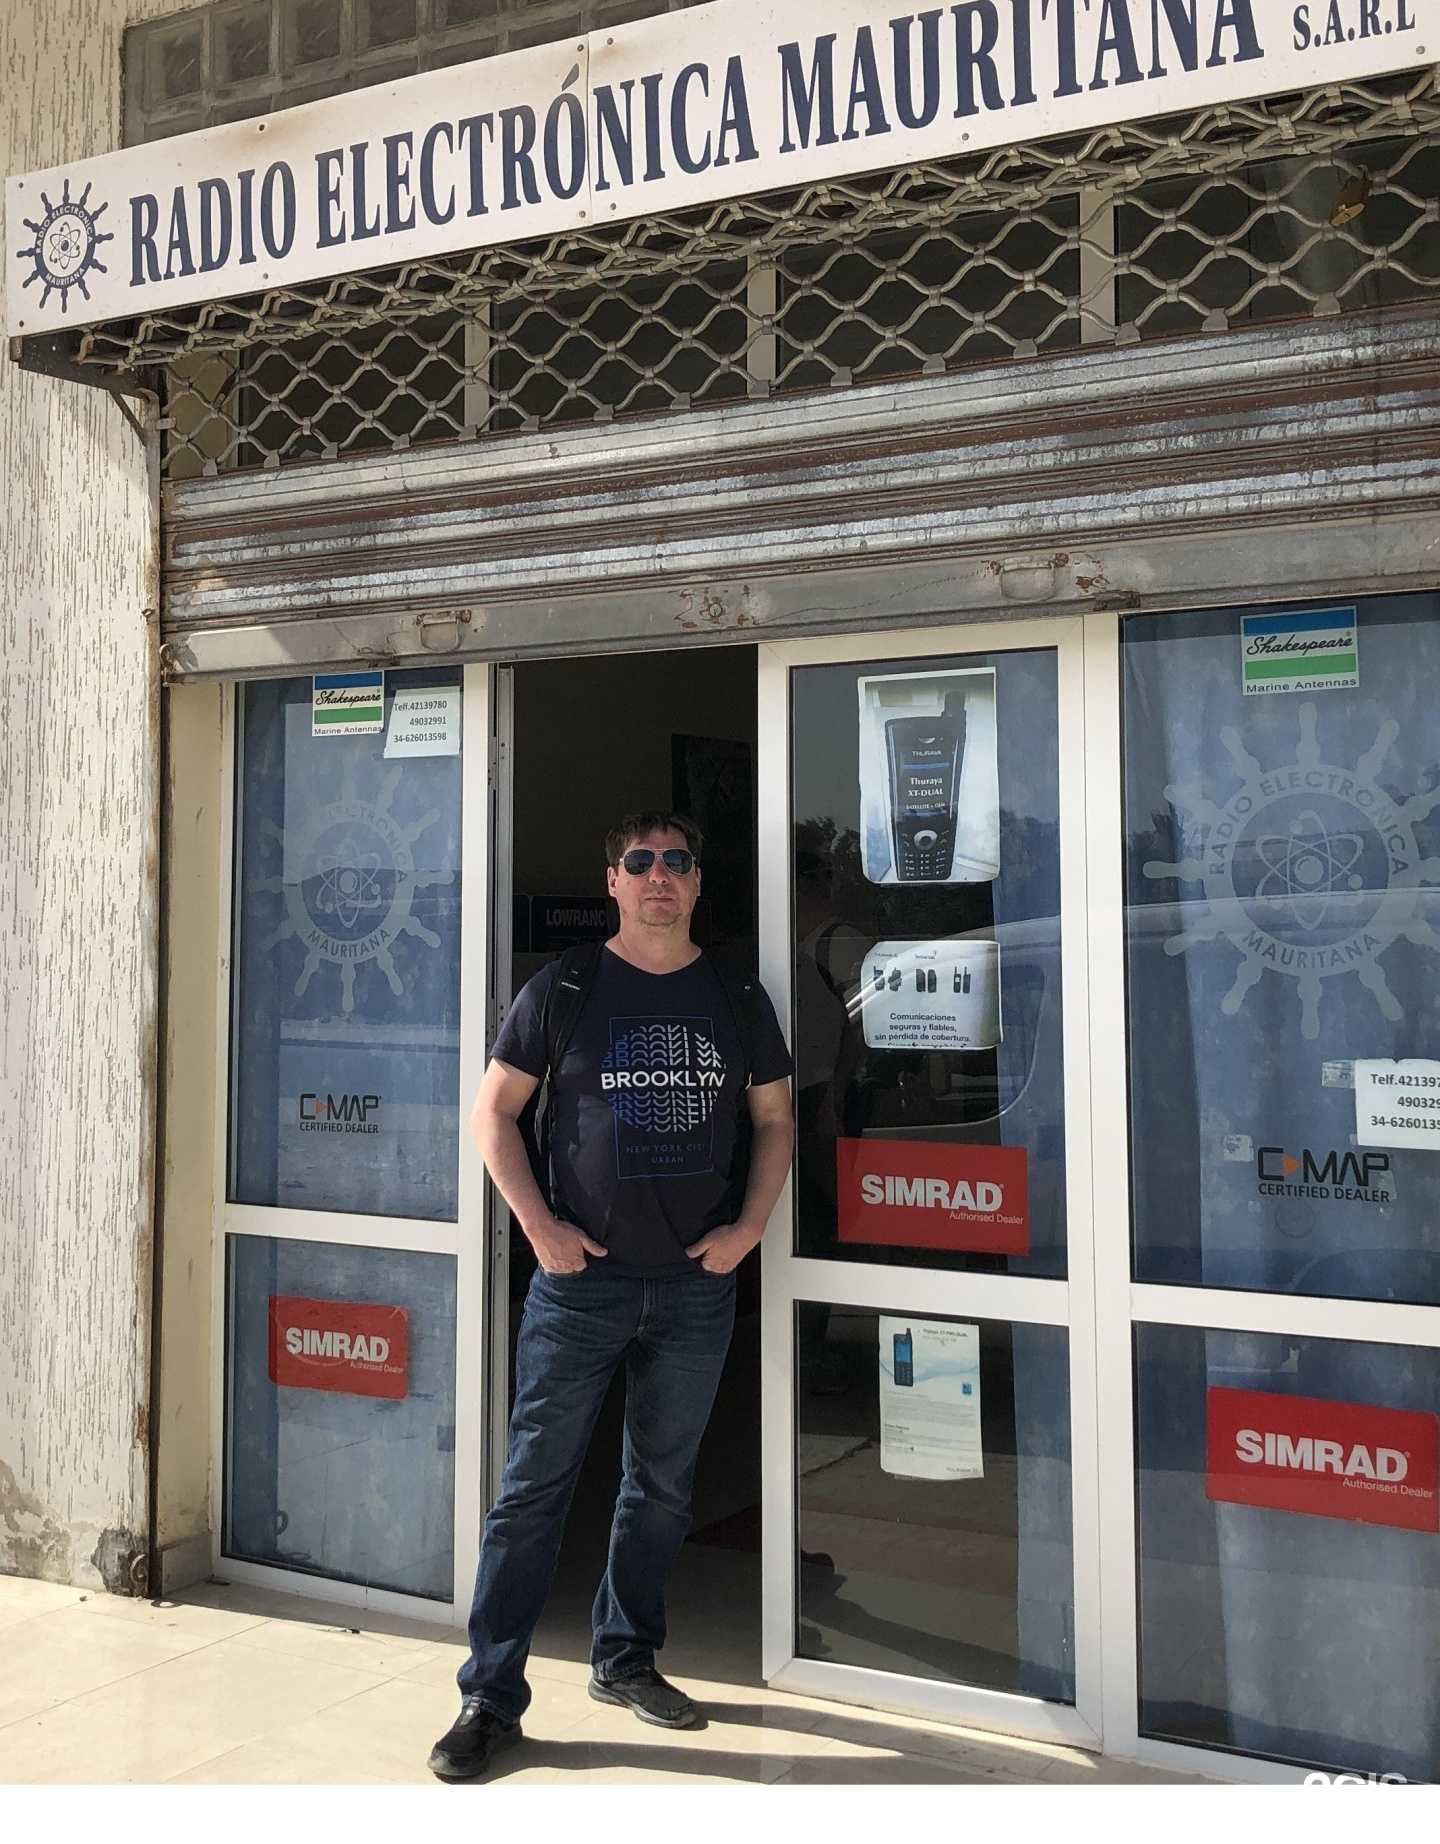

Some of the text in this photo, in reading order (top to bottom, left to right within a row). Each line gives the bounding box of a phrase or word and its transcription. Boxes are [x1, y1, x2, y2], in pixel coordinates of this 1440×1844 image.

[129, 160, 297, 287] RADIO
[315, 55, 759, 248] ELECTRÓNICA
[778, 0, 1264, 153] MAURITANA
[1246, 634, 1353, 656] Shakespeare
[1246, 679, 1357, 694] Marine Antennas
[315, 690, 382, 707] Shakespeare
[409, 716, 447, 726] 49032991
[314, 725, 382, 735] Marine Antennas
[393, 731, 447, 743] 34-626013598
[910, 777, 943, 785] Thuraya
[908, 788, 944, 797] XT-DUAL
[545, 908, 607, 927] LOWRANC
[306, 929, 391, 958] MAURITANA
[1245, 930, 1381, 968] MAURITANA
[889, 1012, 957, 1022] Comunicaciones
[889, 1024, 921, 1032] seguras
[928, 1023, 957, 1032] fiables,
[920, 1033, 930, 1041] de
[601, 1070, 726, 1090] BROOKLYN
[300, 1122, 379, 1134] CERTIFIED DEALER
[861, 1174, 1003, 1212] SIMRAD
[1258, 1182, 1390, 1203] CERTIFIED DEALER
[949, 1211, 1025, 1225] Authorised Dealer
[286, 1327, 390, 1363] SIMRAD
[1235, 1429, 1409, 1482] SIMRAD
[1342, 1477, 1433, 1498] Authorised Dealer
